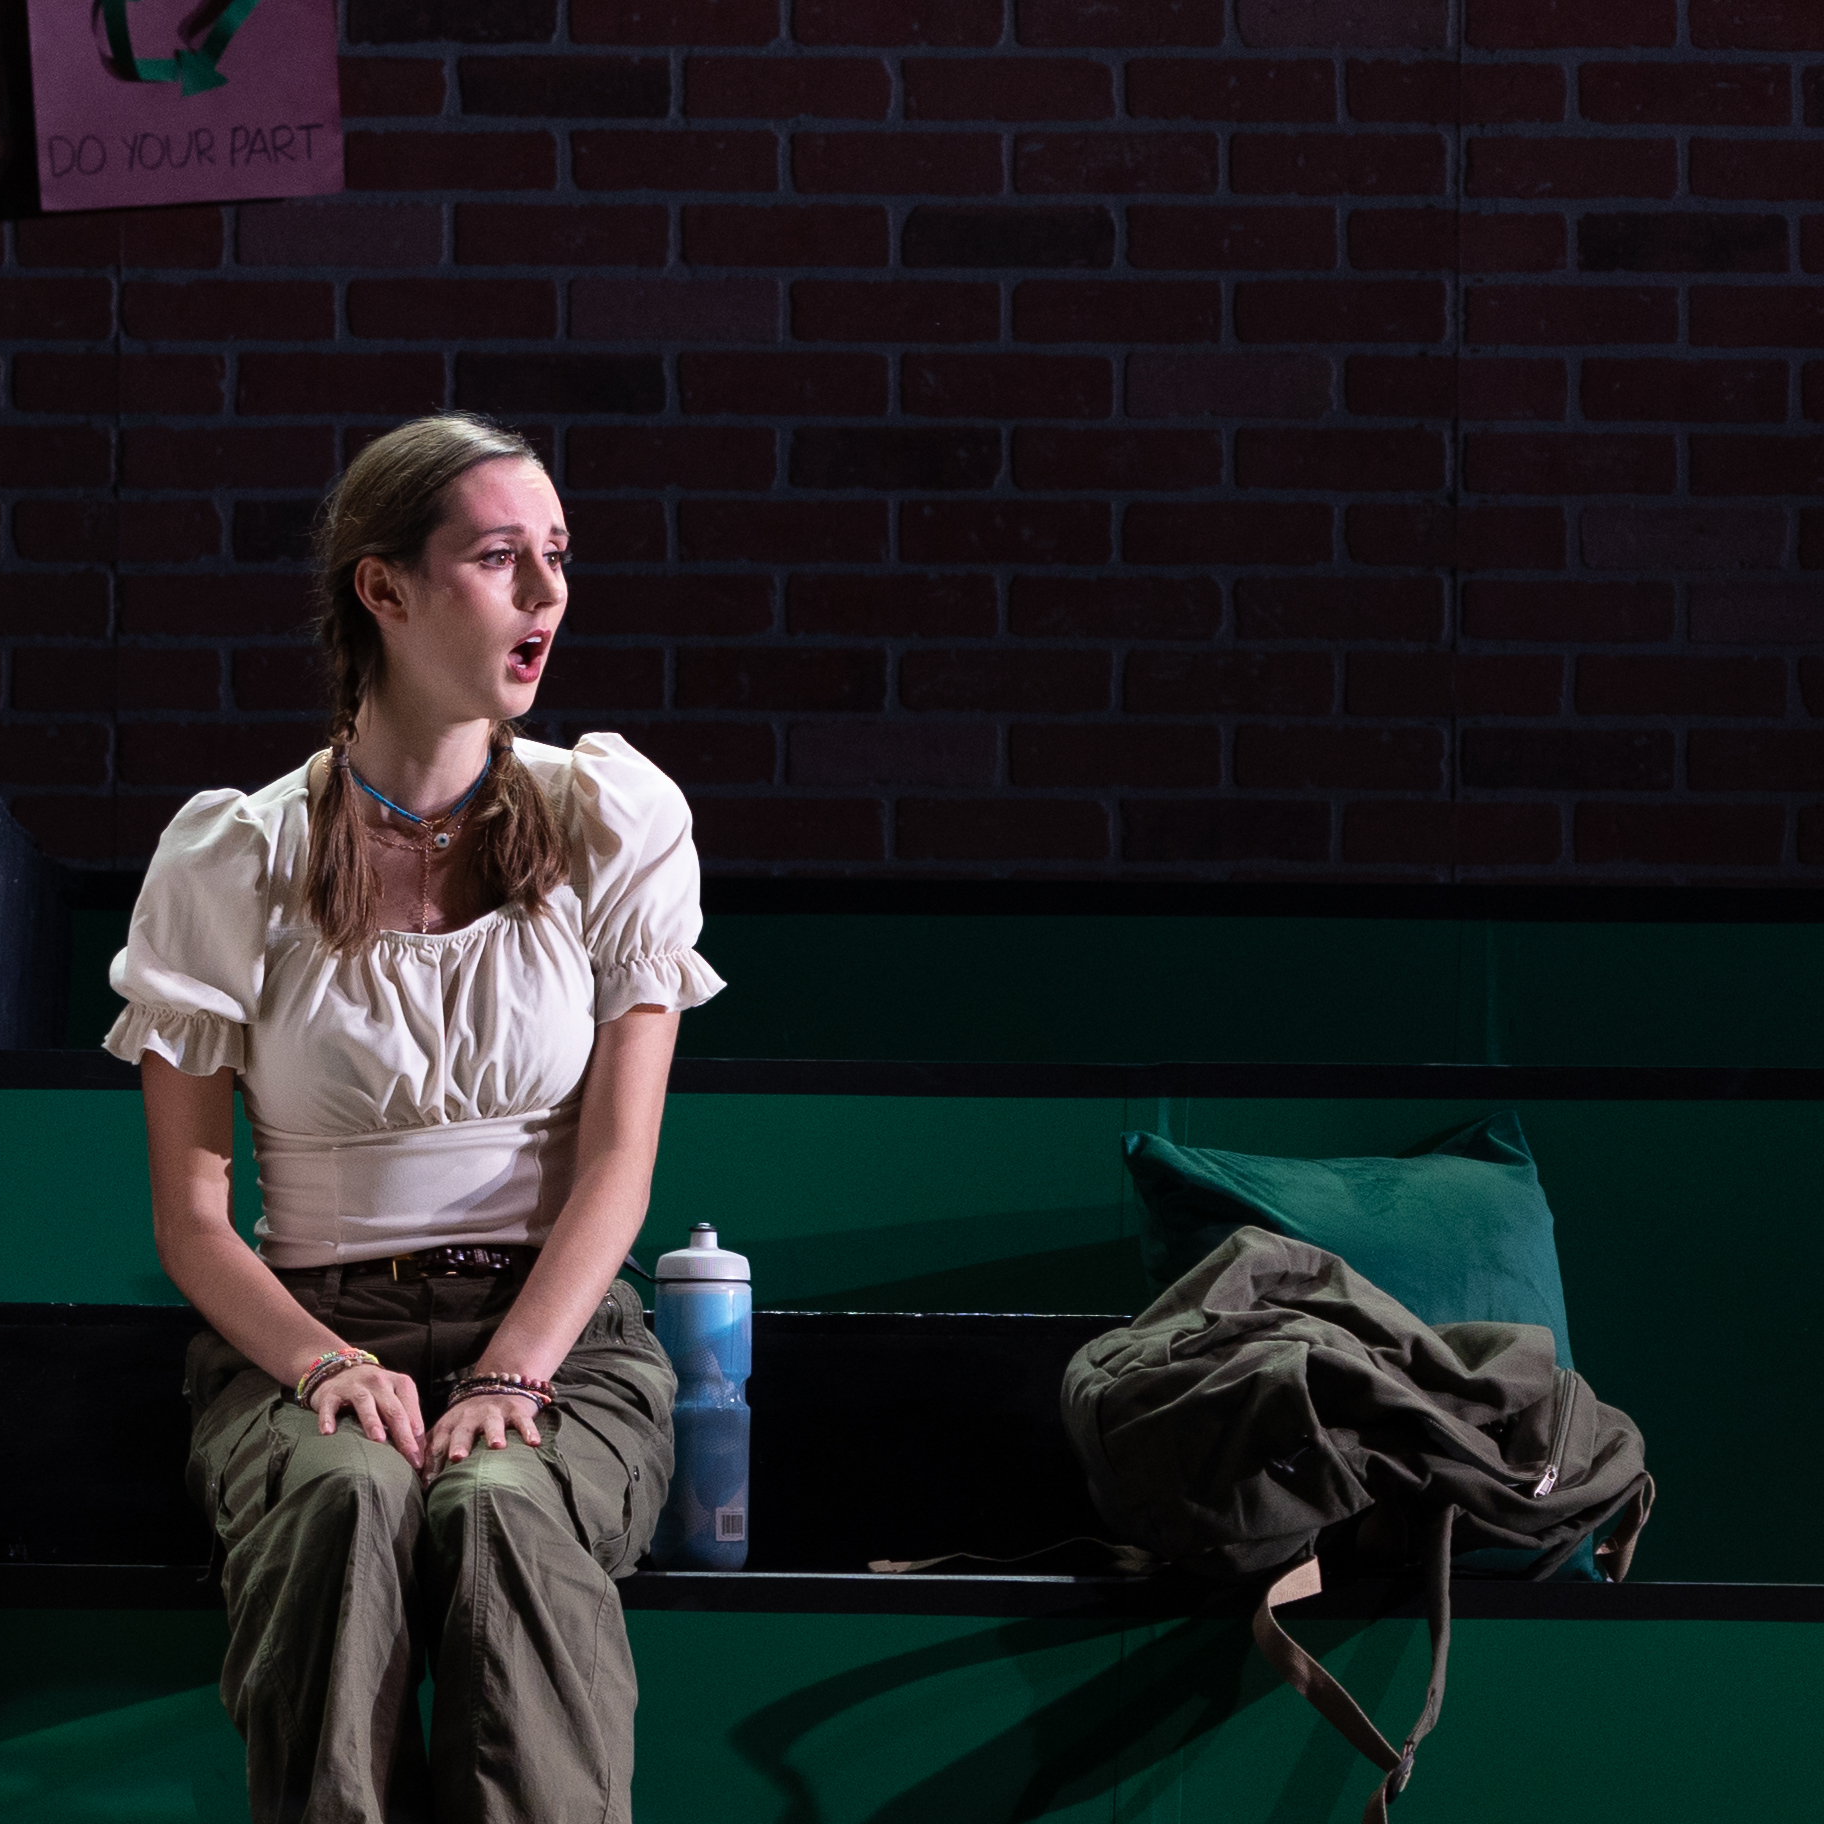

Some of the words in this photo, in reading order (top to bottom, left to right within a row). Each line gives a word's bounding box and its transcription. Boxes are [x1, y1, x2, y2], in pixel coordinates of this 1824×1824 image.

[49, 133, 106, 178] DO
[121, 127, 215, 172] YOUR
[230, 122, 324, 166] PART
